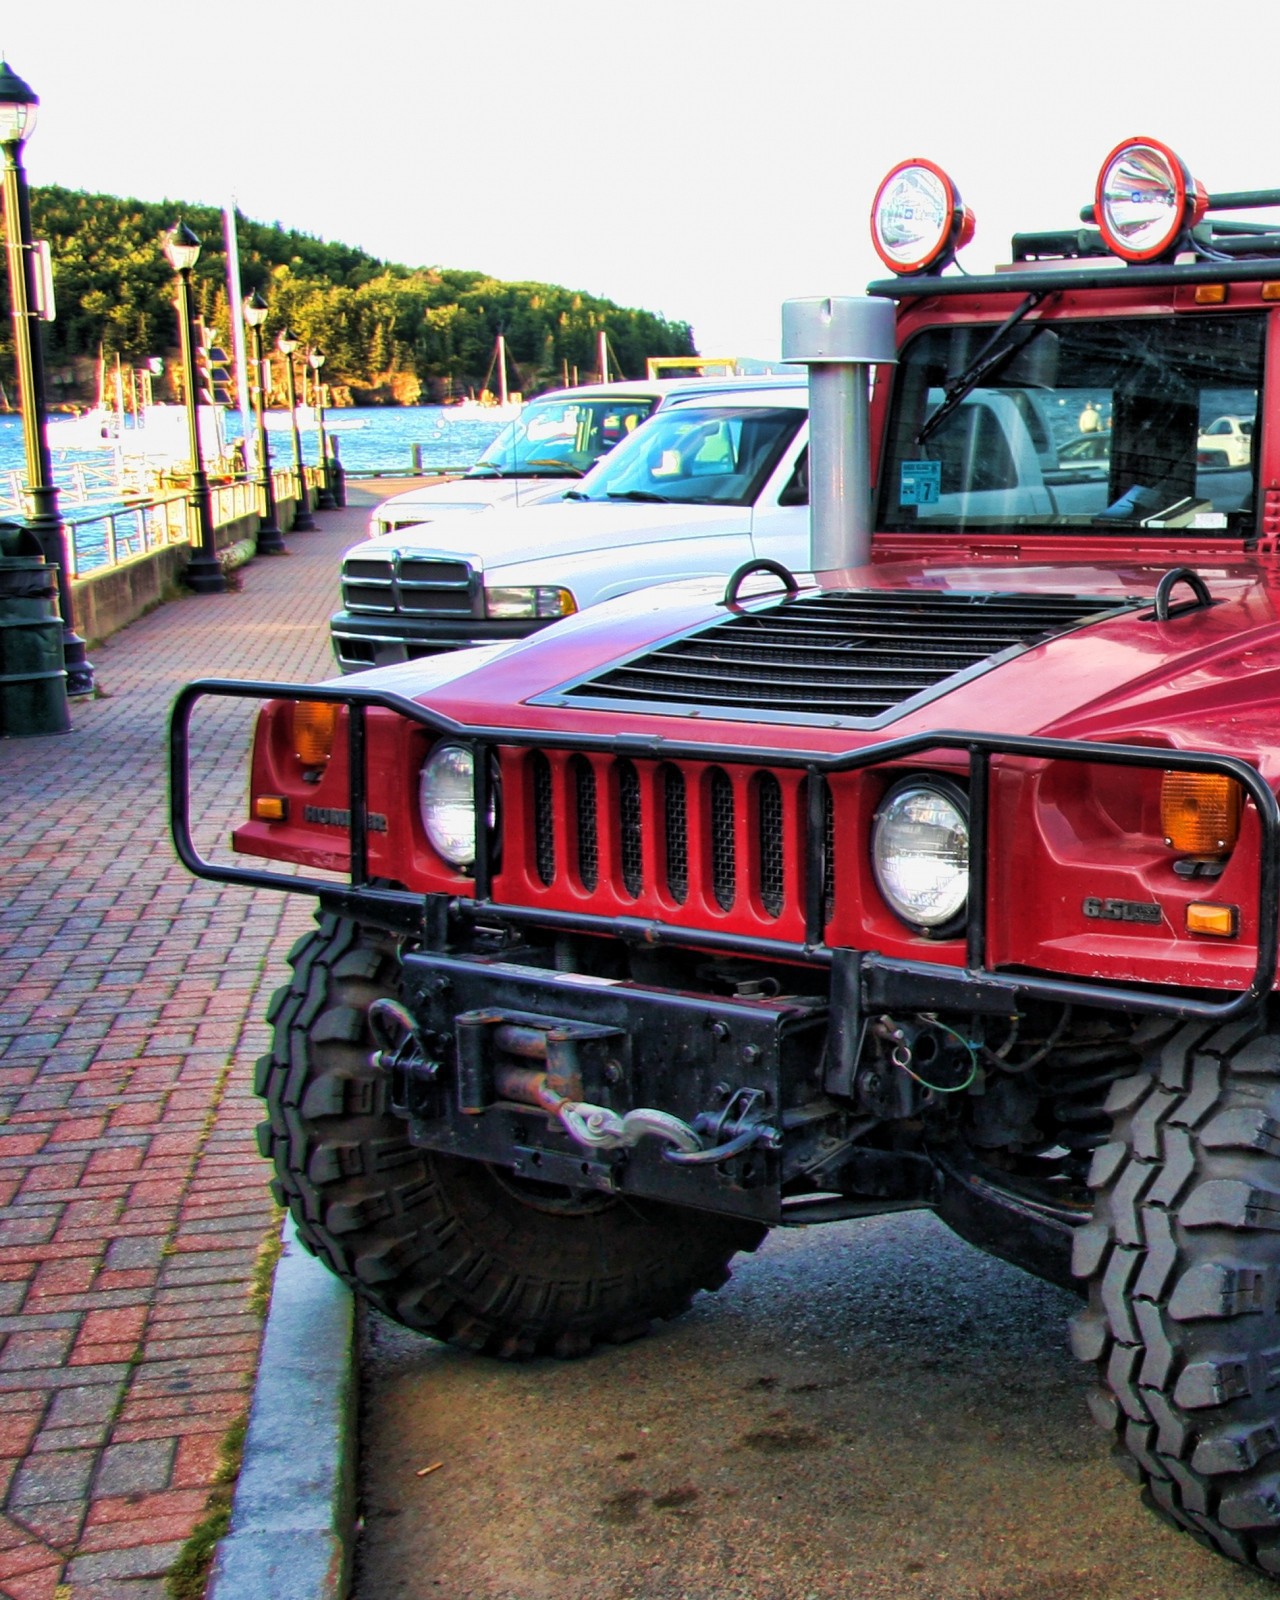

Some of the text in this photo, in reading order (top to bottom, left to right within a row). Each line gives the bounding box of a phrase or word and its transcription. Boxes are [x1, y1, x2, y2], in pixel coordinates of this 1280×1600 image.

[923, 482, 931, 501] 7
[305, 805, 387, 832] HUMER
[1083, 897, 1137, 921] 6.5L
